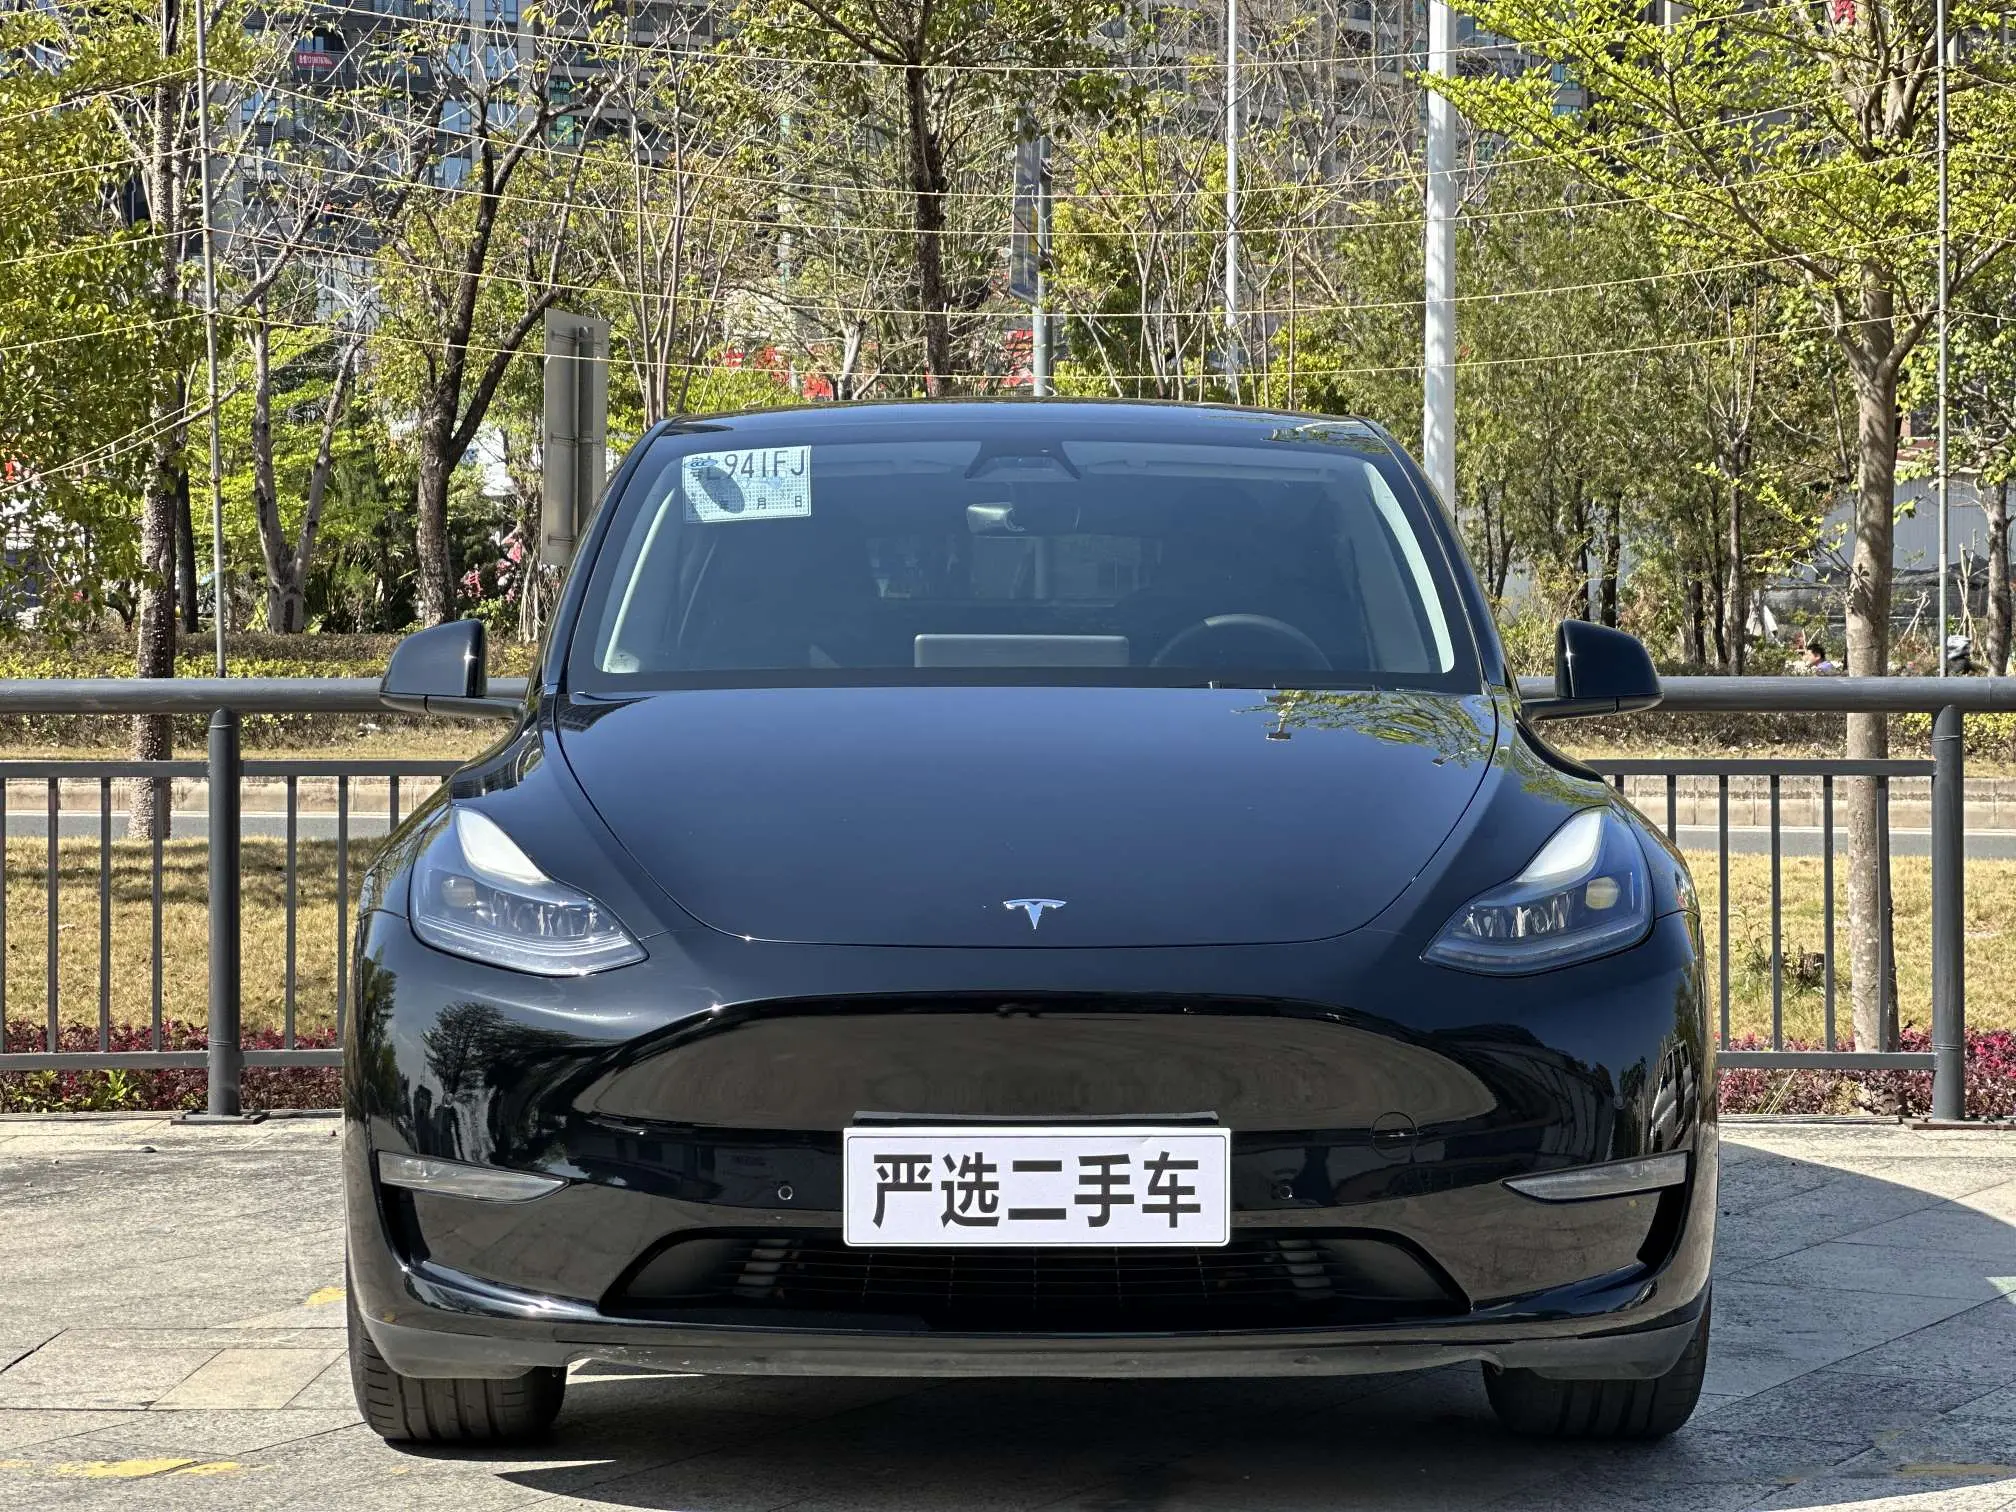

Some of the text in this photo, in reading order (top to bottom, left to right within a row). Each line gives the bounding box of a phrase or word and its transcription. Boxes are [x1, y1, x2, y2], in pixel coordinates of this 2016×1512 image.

[757, 497, 767, 509] 月
[794, 495, 802, 508] 日
[872, 1151, 1201, 1228] 严选二手车
